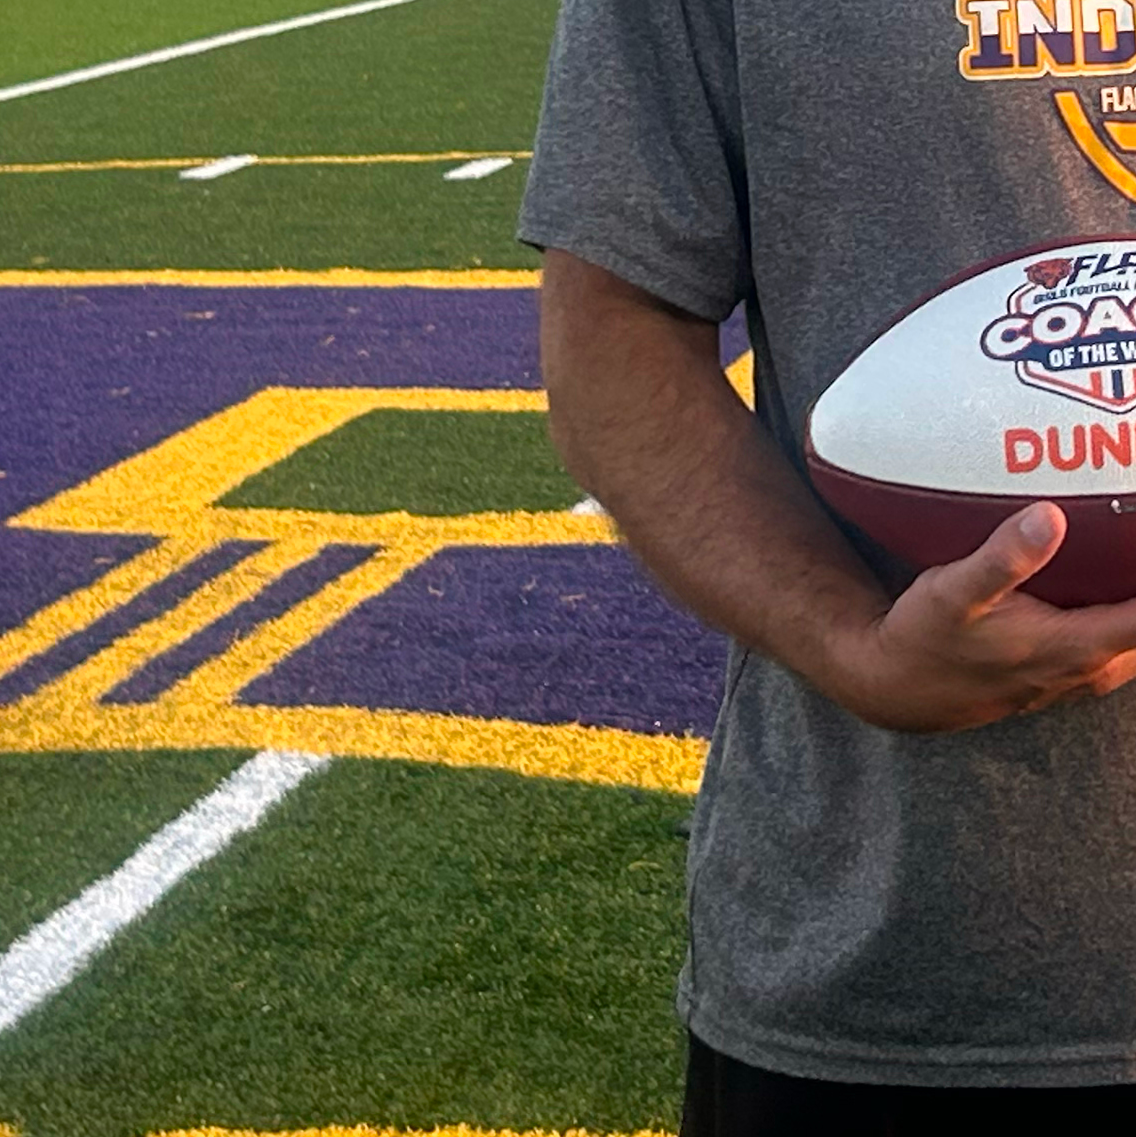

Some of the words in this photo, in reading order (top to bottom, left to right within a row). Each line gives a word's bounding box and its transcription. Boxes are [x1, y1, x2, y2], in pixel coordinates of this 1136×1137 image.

[1069, 279, 1130, 298] FOOTBALL
[1049, 348, 1077, 368] OF
[1078, 342, 1119, 364] THE
